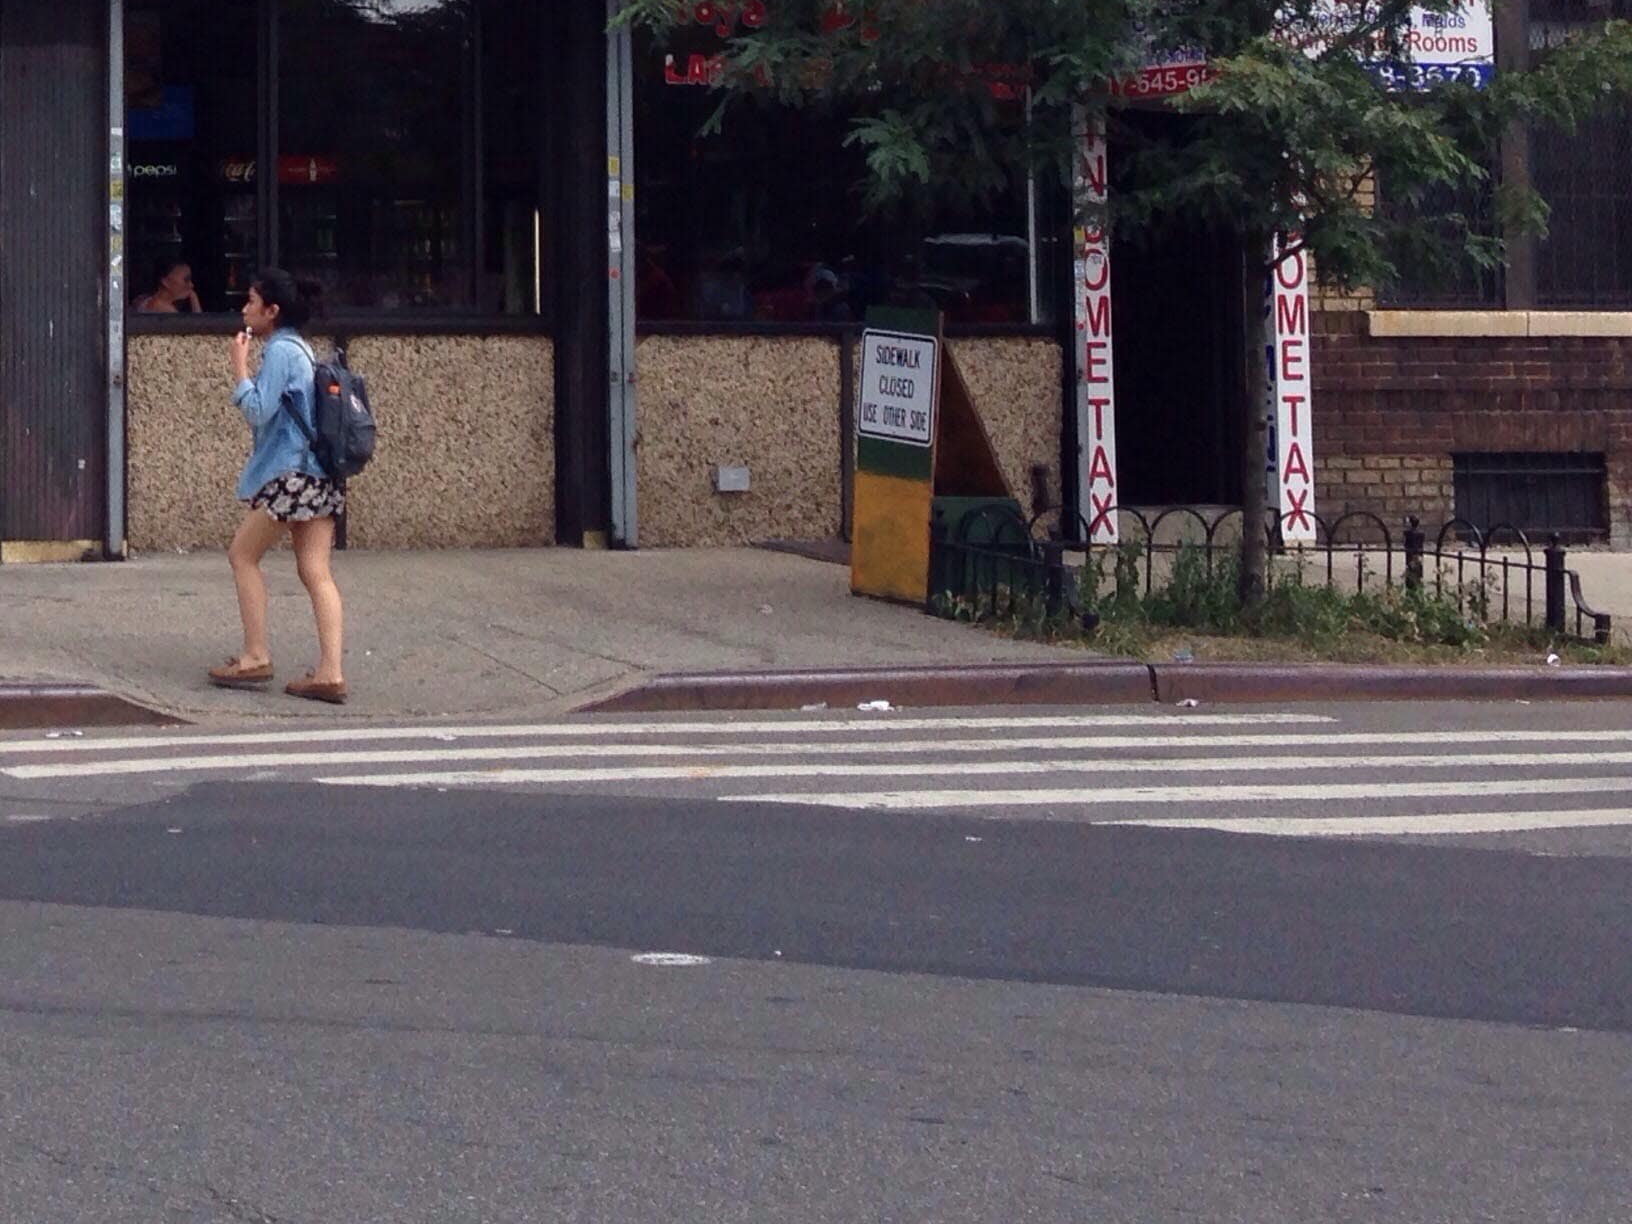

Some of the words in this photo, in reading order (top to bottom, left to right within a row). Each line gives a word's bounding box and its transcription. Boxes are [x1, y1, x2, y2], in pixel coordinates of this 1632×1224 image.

[1409, 30, 1478, 53] Rooms
[133, 163, 177, 178] pepsi
[876, 345, 920, 369] SIDEWALK
[879, 374, 915, 399] CLOSED
[863, 402, 877, 424] USE
[883, 405, 906, 427] OTHER
[910, 409, 927, 432] SIDE
[1087, 398, 1115, 537] TAX
[1281, 395, 1311, 533] TAX
